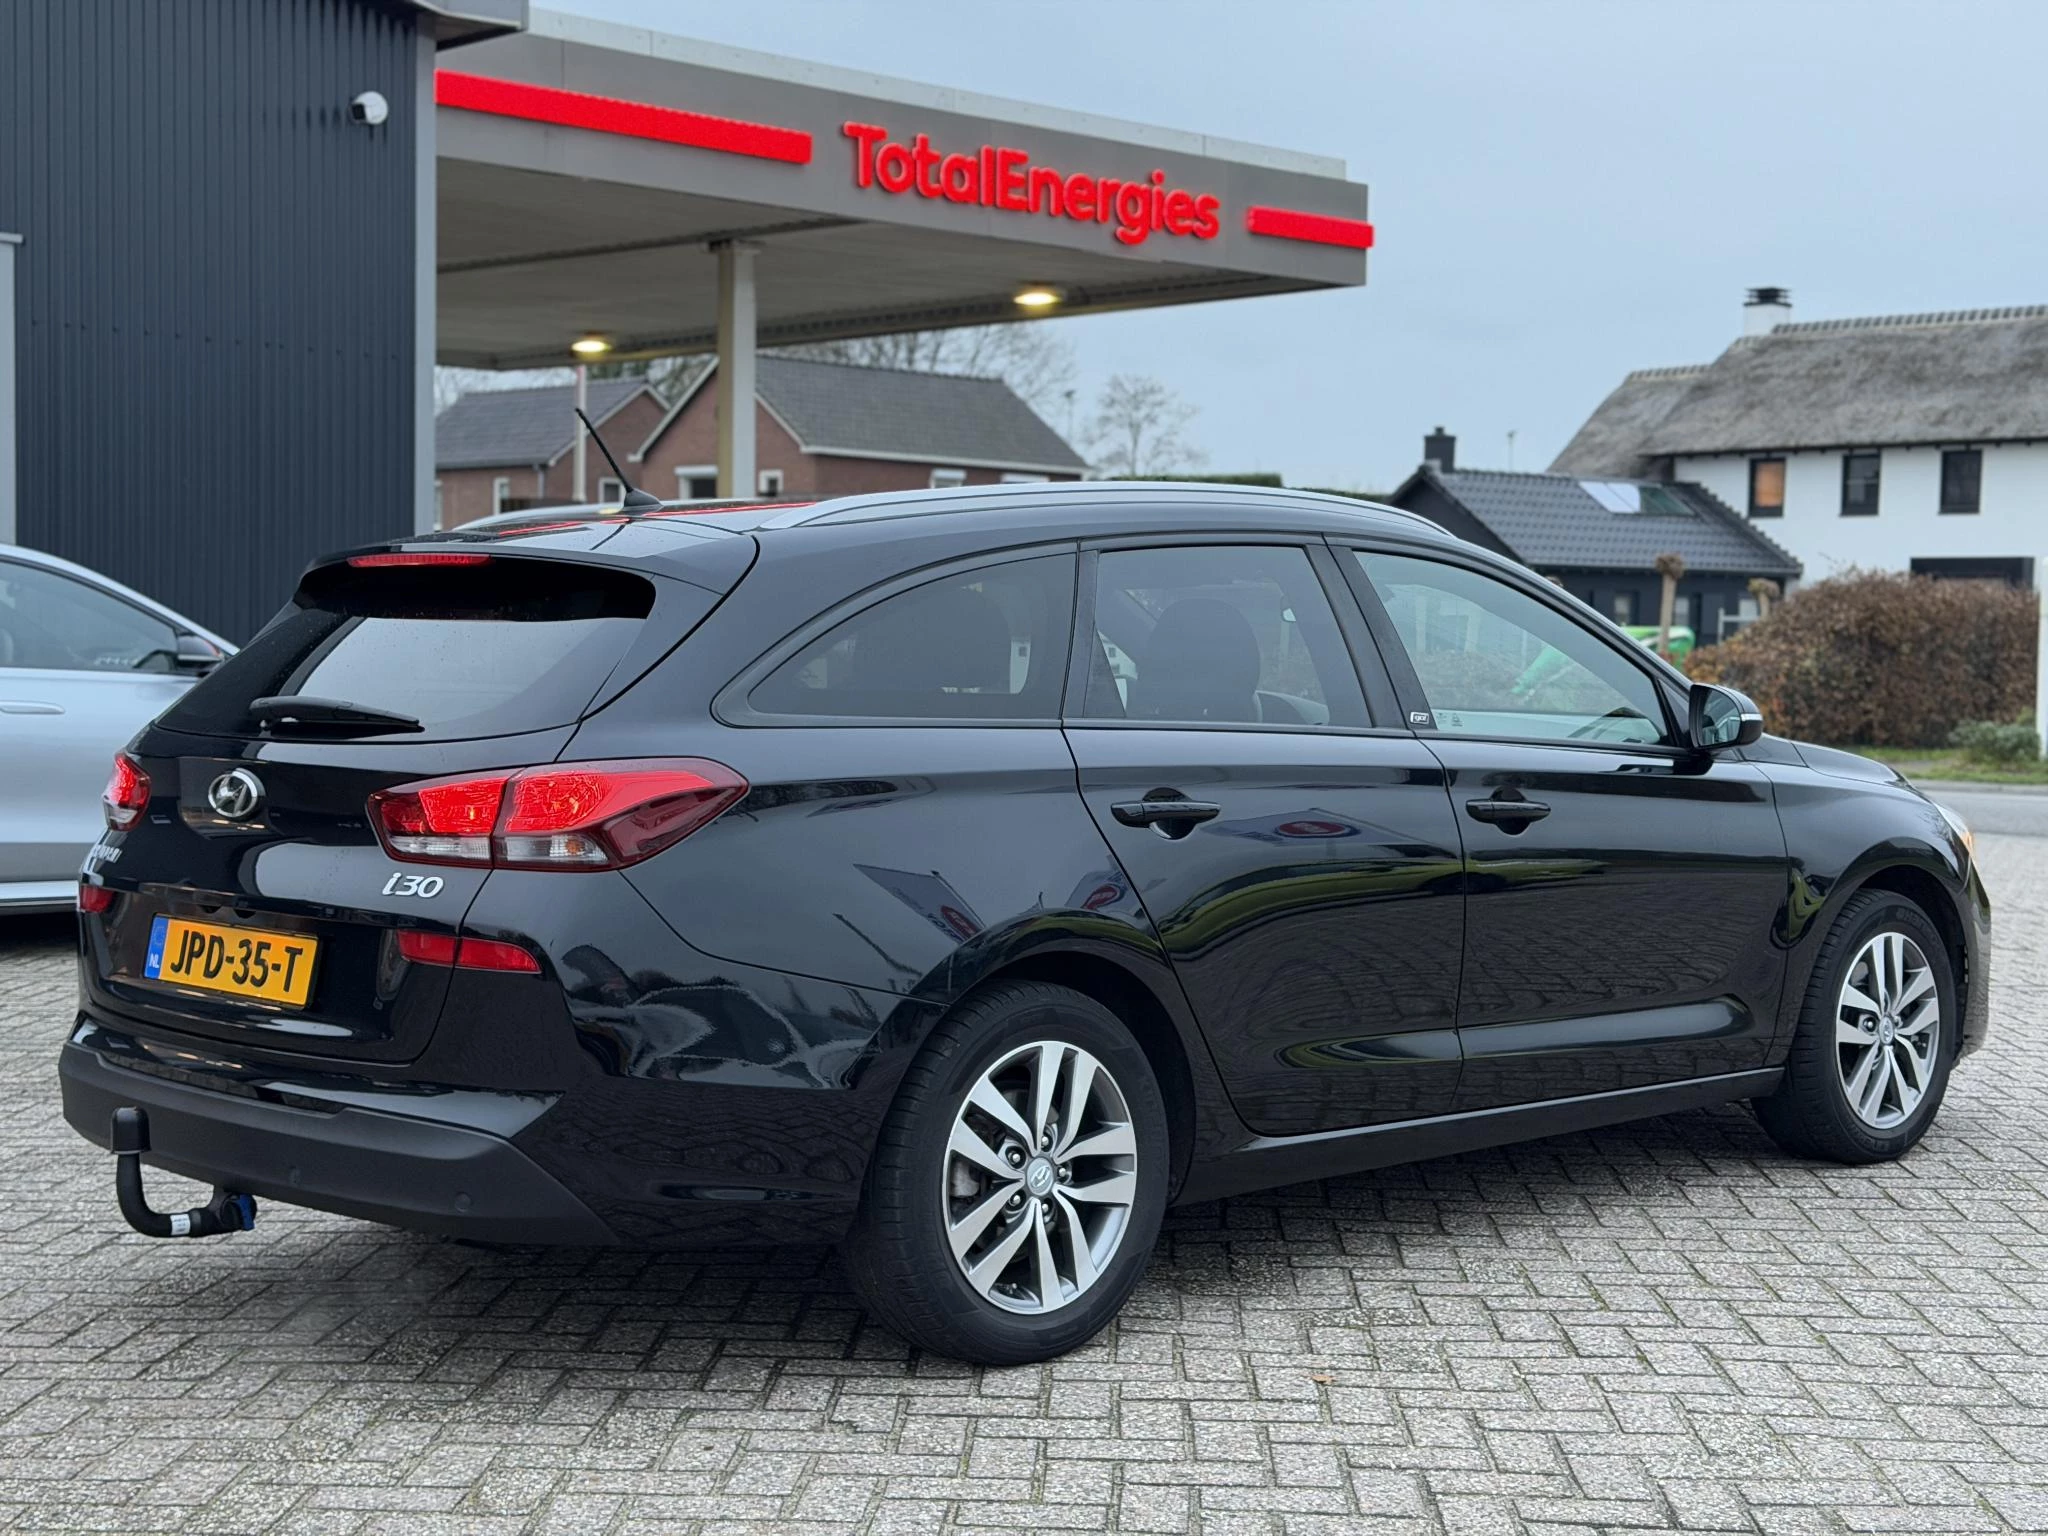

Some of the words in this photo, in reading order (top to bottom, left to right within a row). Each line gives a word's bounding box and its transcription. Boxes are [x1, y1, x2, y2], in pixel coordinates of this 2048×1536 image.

[843, 121, 1220, 245] TotalEnergies
[382, 872, 444, 898] i30
[149, 953, 160, 969] NL
[170, 929, 304, 993] JPD-35-T
